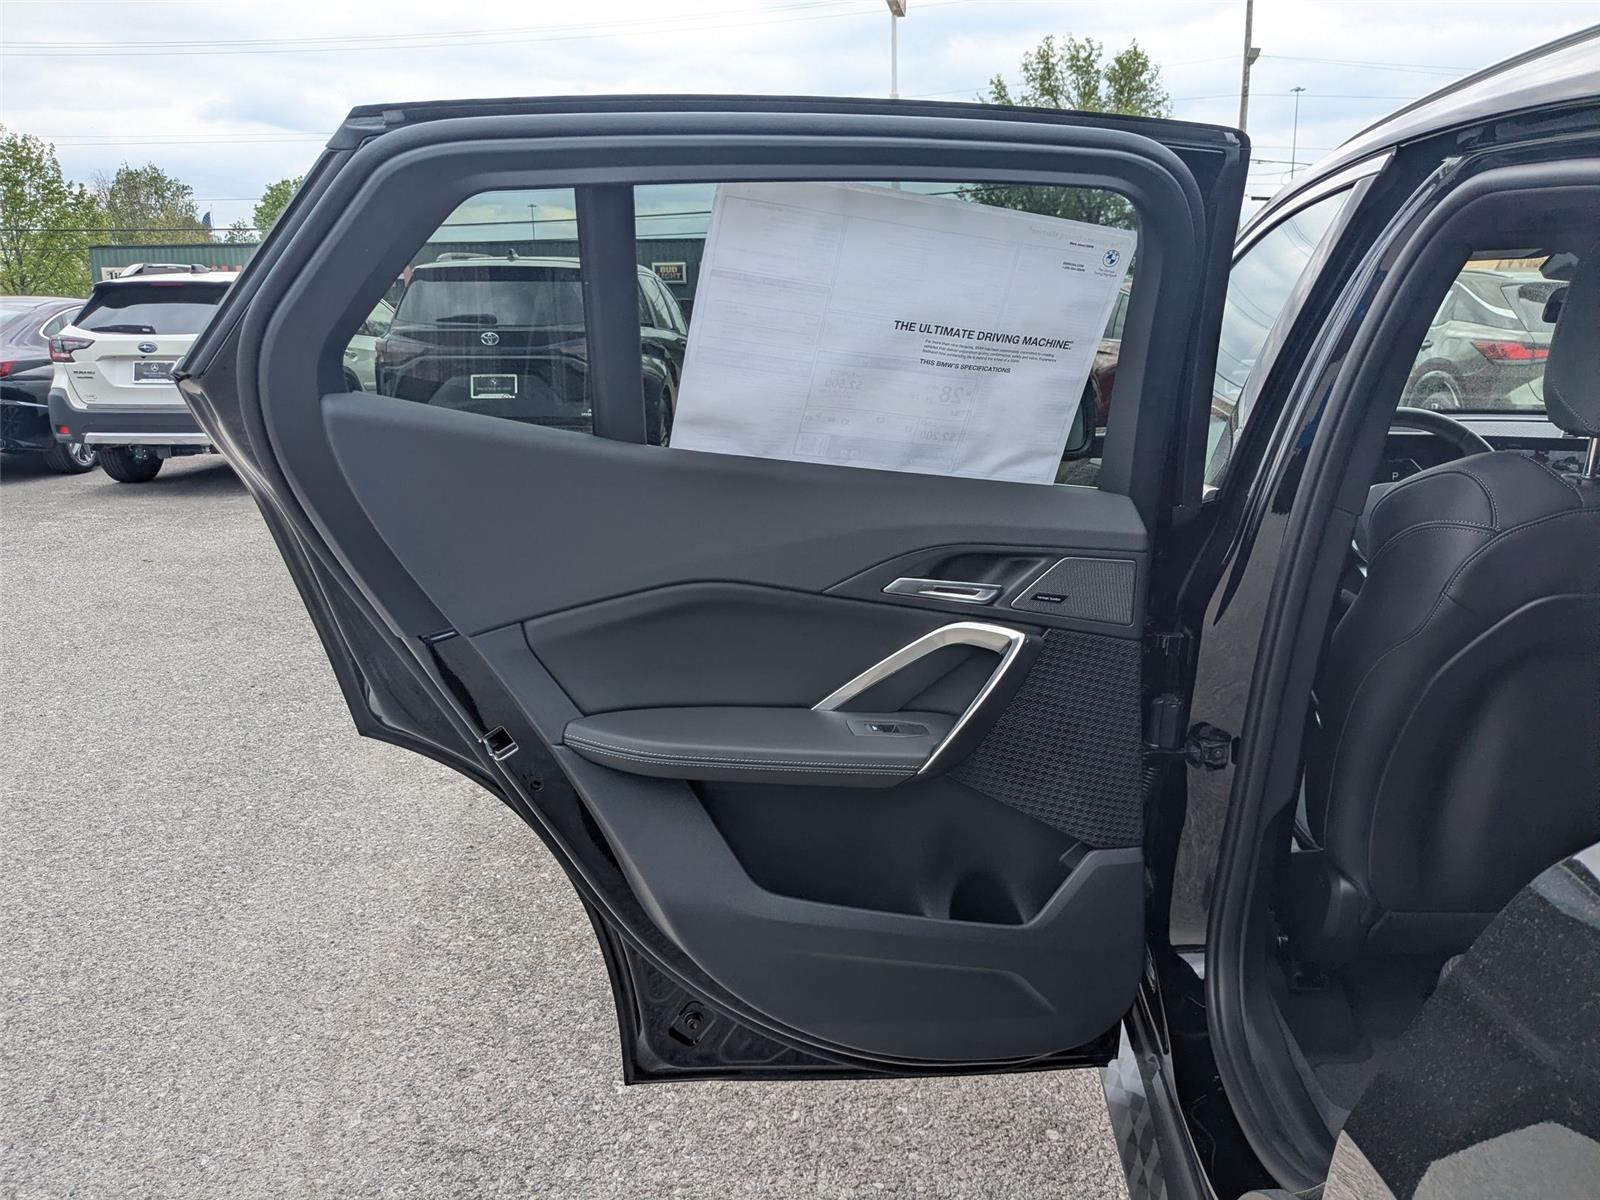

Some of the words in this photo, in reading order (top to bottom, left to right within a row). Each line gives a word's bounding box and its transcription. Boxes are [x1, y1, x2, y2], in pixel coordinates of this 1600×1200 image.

[894, 320, 917, 332] THE
[918, 323, 976, 340] ULTIMATE
[977, 331, 1021, 345] DRIVING
[920, 358, 935, 366] THIS
[936, 361, 959, 369] BMW'S
[960, 363, 1011, 373] SPECIFICATIONS
[1392, 472, 1399, 480] P
